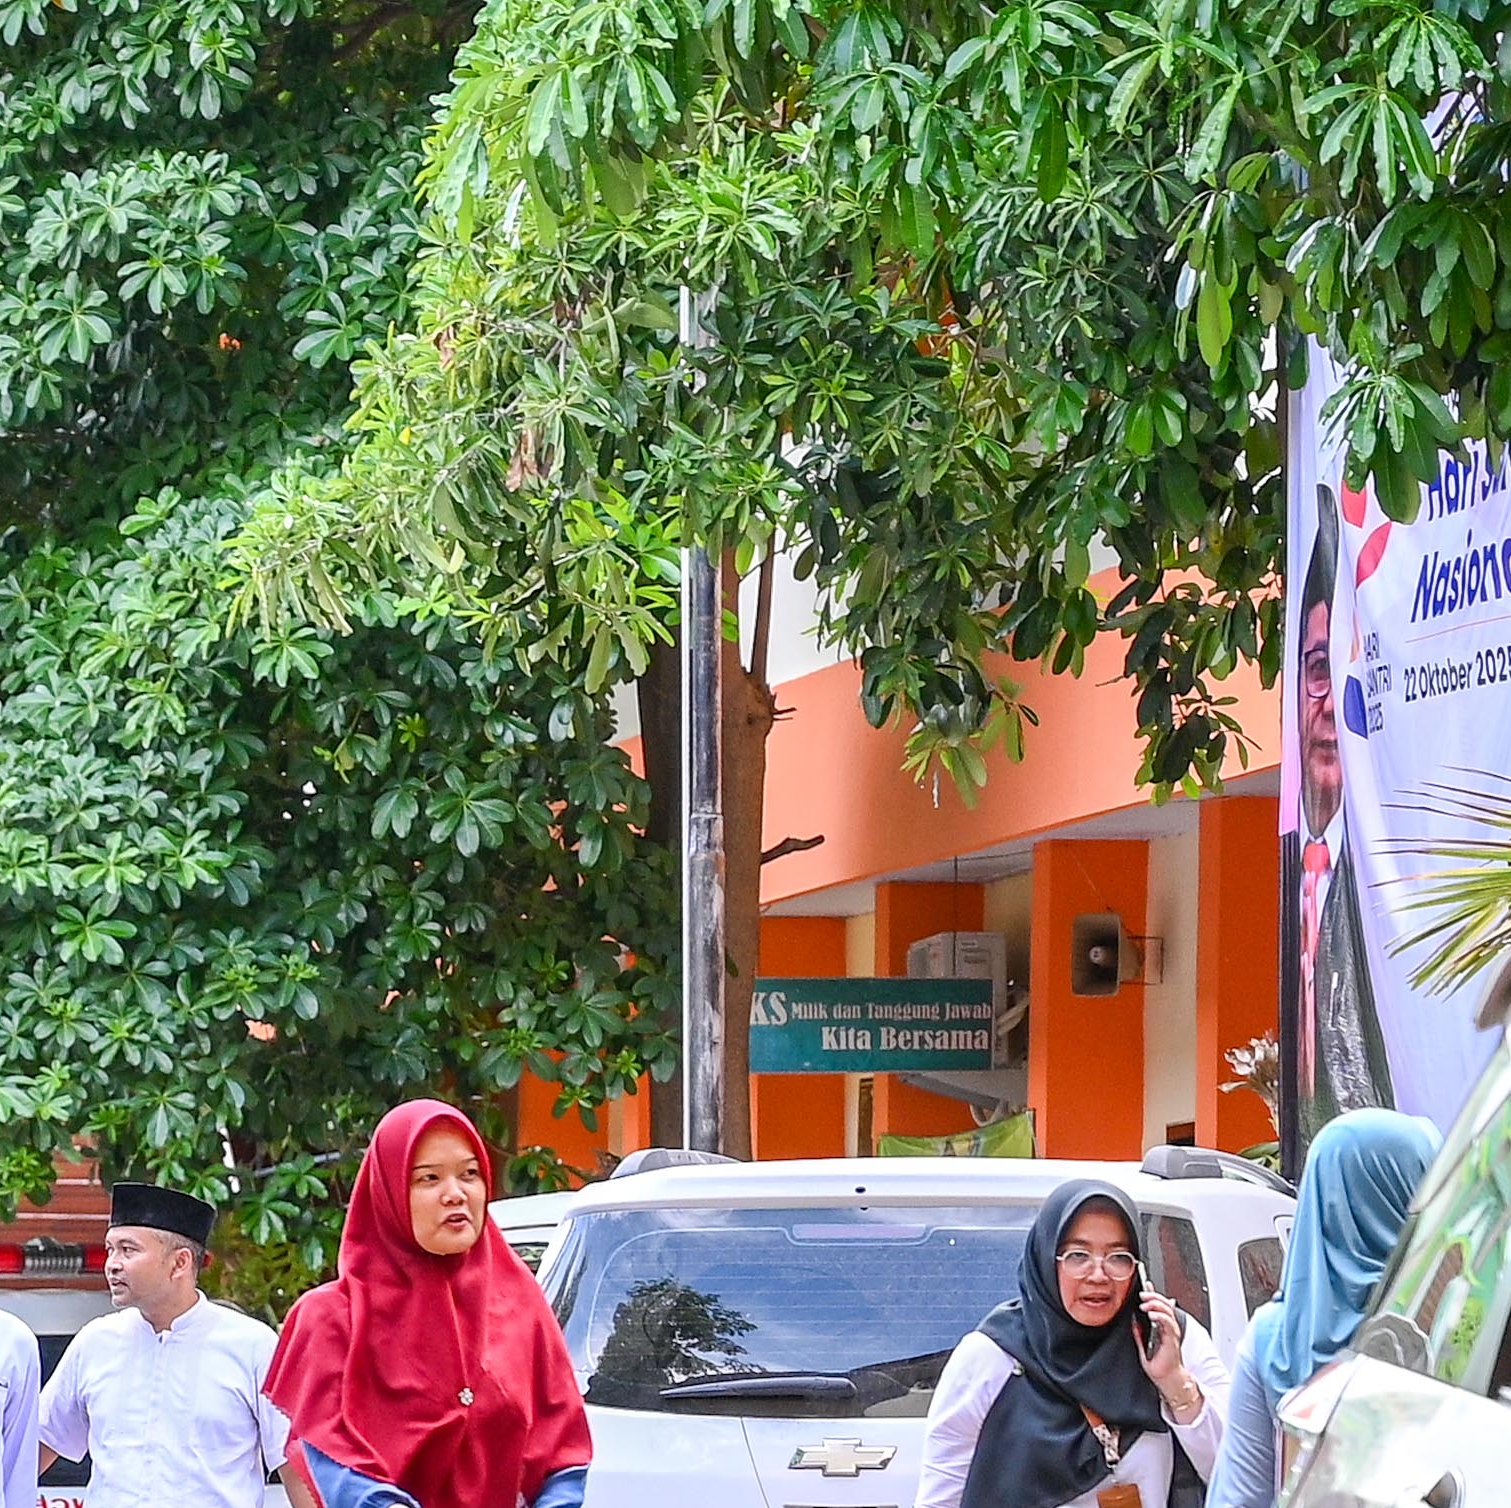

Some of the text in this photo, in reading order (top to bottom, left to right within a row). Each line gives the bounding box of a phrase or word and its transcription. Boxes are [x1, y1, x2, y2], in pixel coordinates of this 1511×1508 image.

[1404, 667, 1418, 702] 22
[1419, 657, 1473, 699] Oktober
[791, 1001, 829, 1020] Milik
[833, 1002, 862, 1020] dan
[866, 1001, 941, 1022] Tanggung
[944, 1002, 992, 1021] Jawab
[821, 1026, 989, 1051] Kita Bersama
